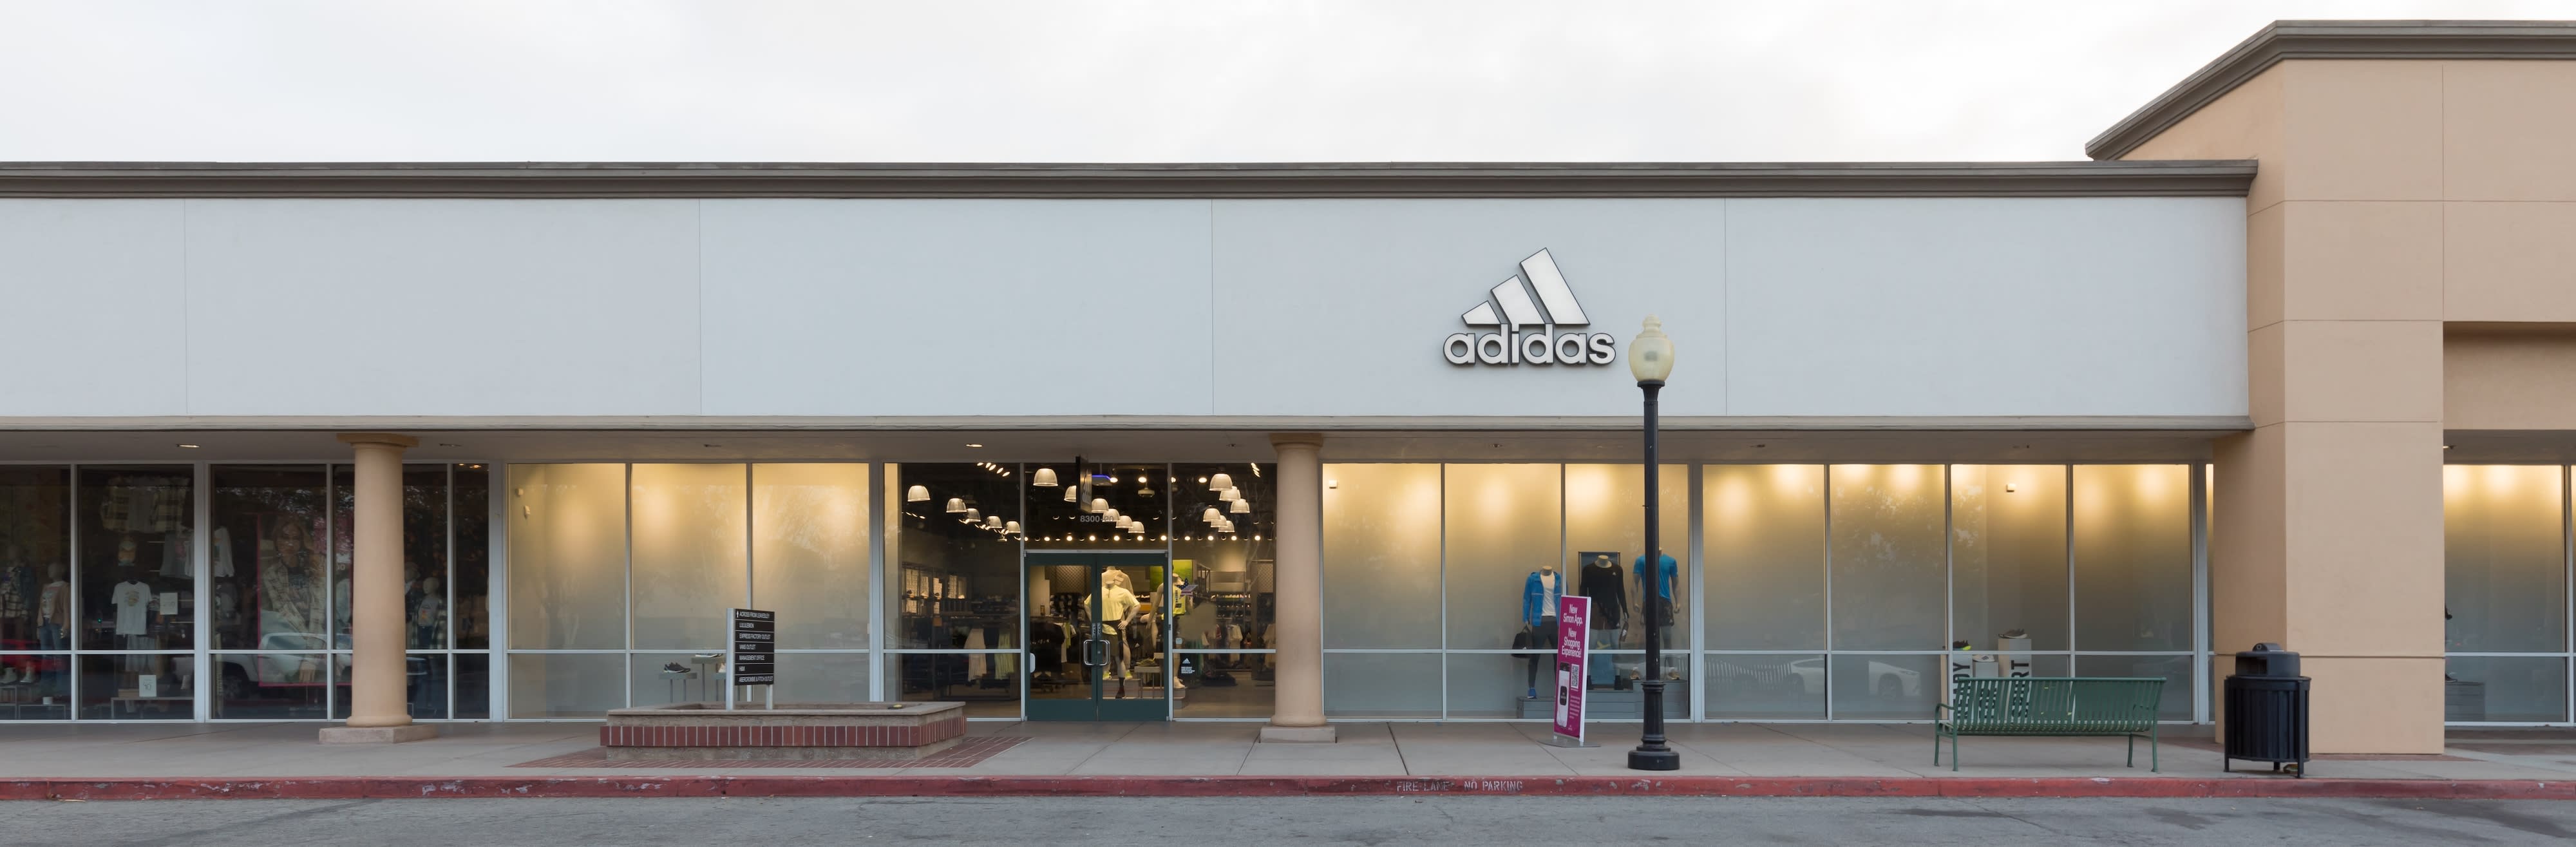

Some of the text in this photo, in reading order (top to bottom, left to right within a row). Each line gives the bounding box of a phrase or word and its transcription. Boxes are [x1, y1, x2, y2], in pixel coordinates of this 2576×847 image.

[1443, 323, 1616, 365] adidas
[1569, 604, 1578, 614] New
[1563, 613, 1583, 627] Simon App.
[1567, 627, 1577, 638] New
[1564, 636, 1580, 650] Shopping
[1561, 645, 1582, 658] Experience!
[1397, 780, 1523, 792] FIRE LANE NO PARKING
